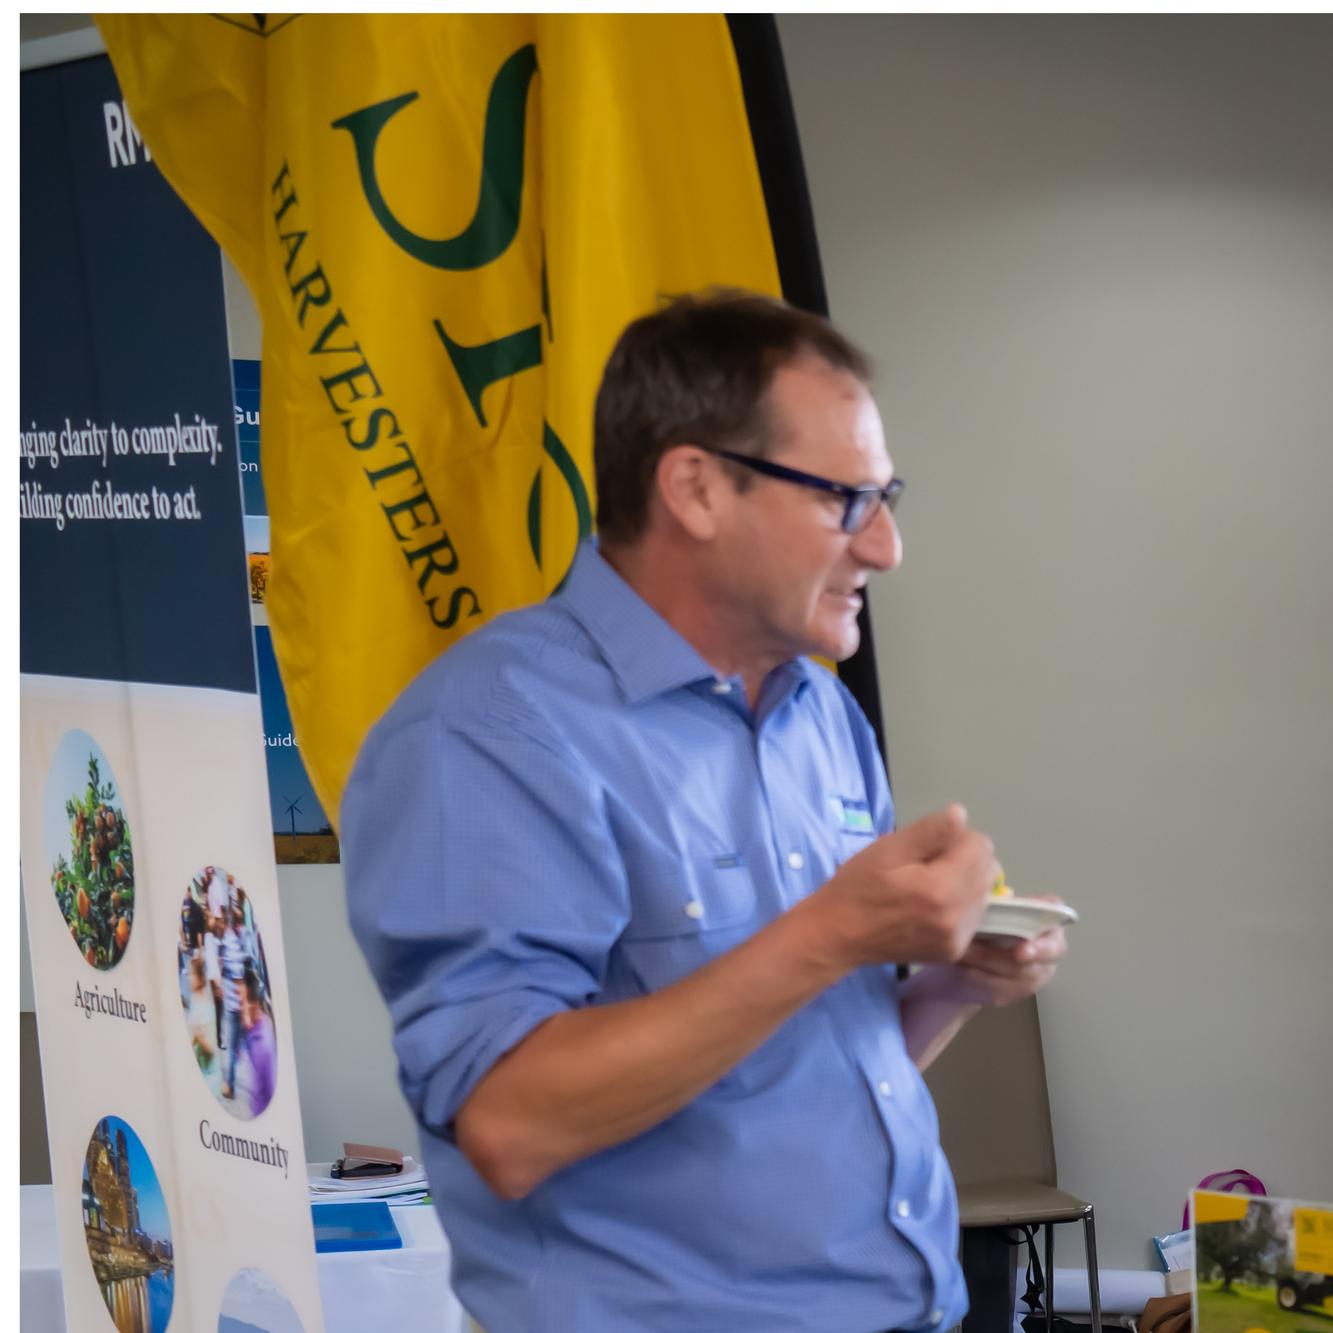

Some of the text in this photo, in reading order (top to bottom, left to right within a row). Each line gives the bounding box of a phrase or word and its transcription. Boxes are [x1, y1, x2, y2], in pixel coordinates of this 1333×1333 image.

[271, 158, 482, 630] HARVESTERS
[59, 418, 108, 467] clarity
[110, 421, 129, 455] to
[131, 413, 223, 466] complexity.
[65, 480, 149, 519] confidence
[152, 486, 171, 519] to
[173, 485, 201, 520] act.
[74, 979, 147, 1025] Agriculture
[199, 1119, 290, 1180] Community
